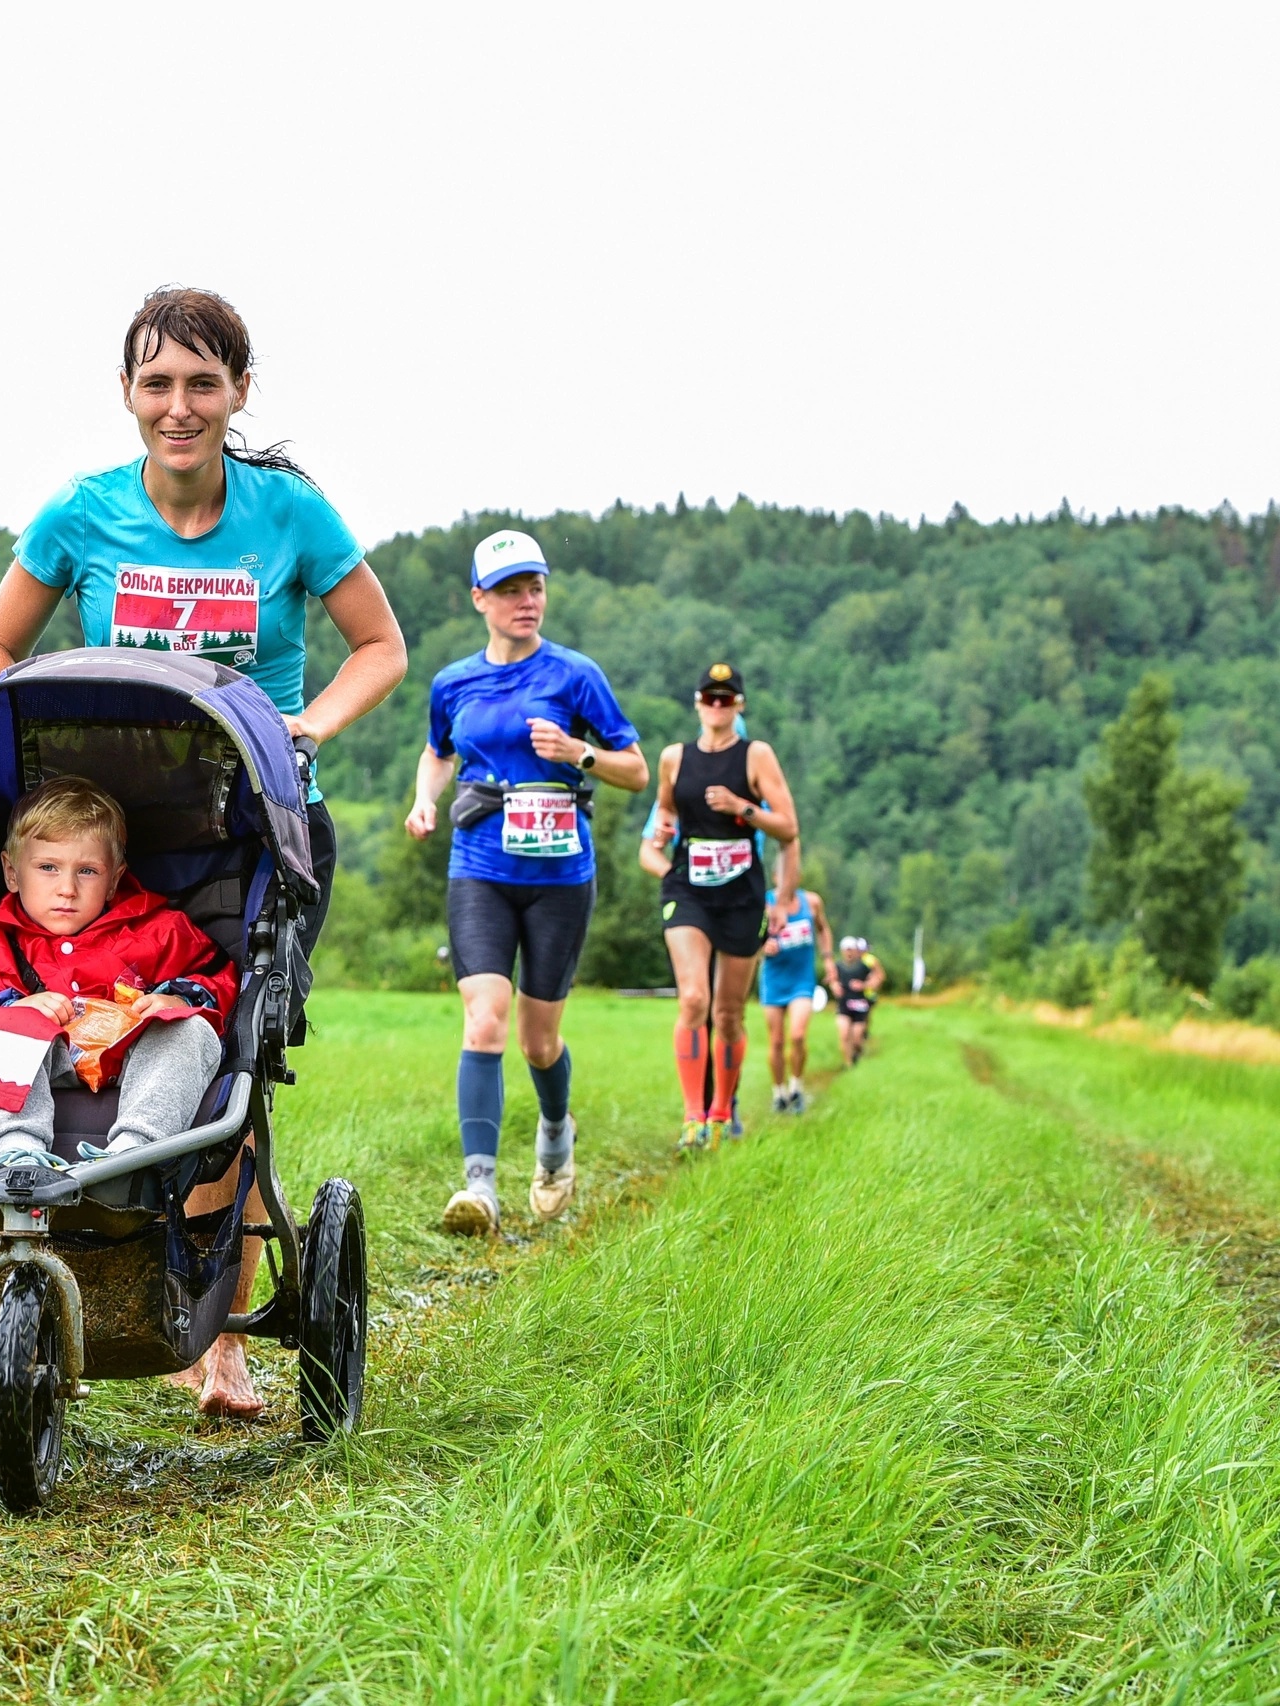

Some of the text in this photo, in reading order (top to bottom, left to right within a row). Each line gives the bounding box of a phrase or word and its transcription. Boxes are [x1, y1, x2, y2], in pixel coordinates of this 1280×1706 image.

[121, 571, 255, 597] ОЛЬГА БЕКРИЦКАЯ
[172, 600, 197, 629] 7
[532, 811, 556, 830] 16
